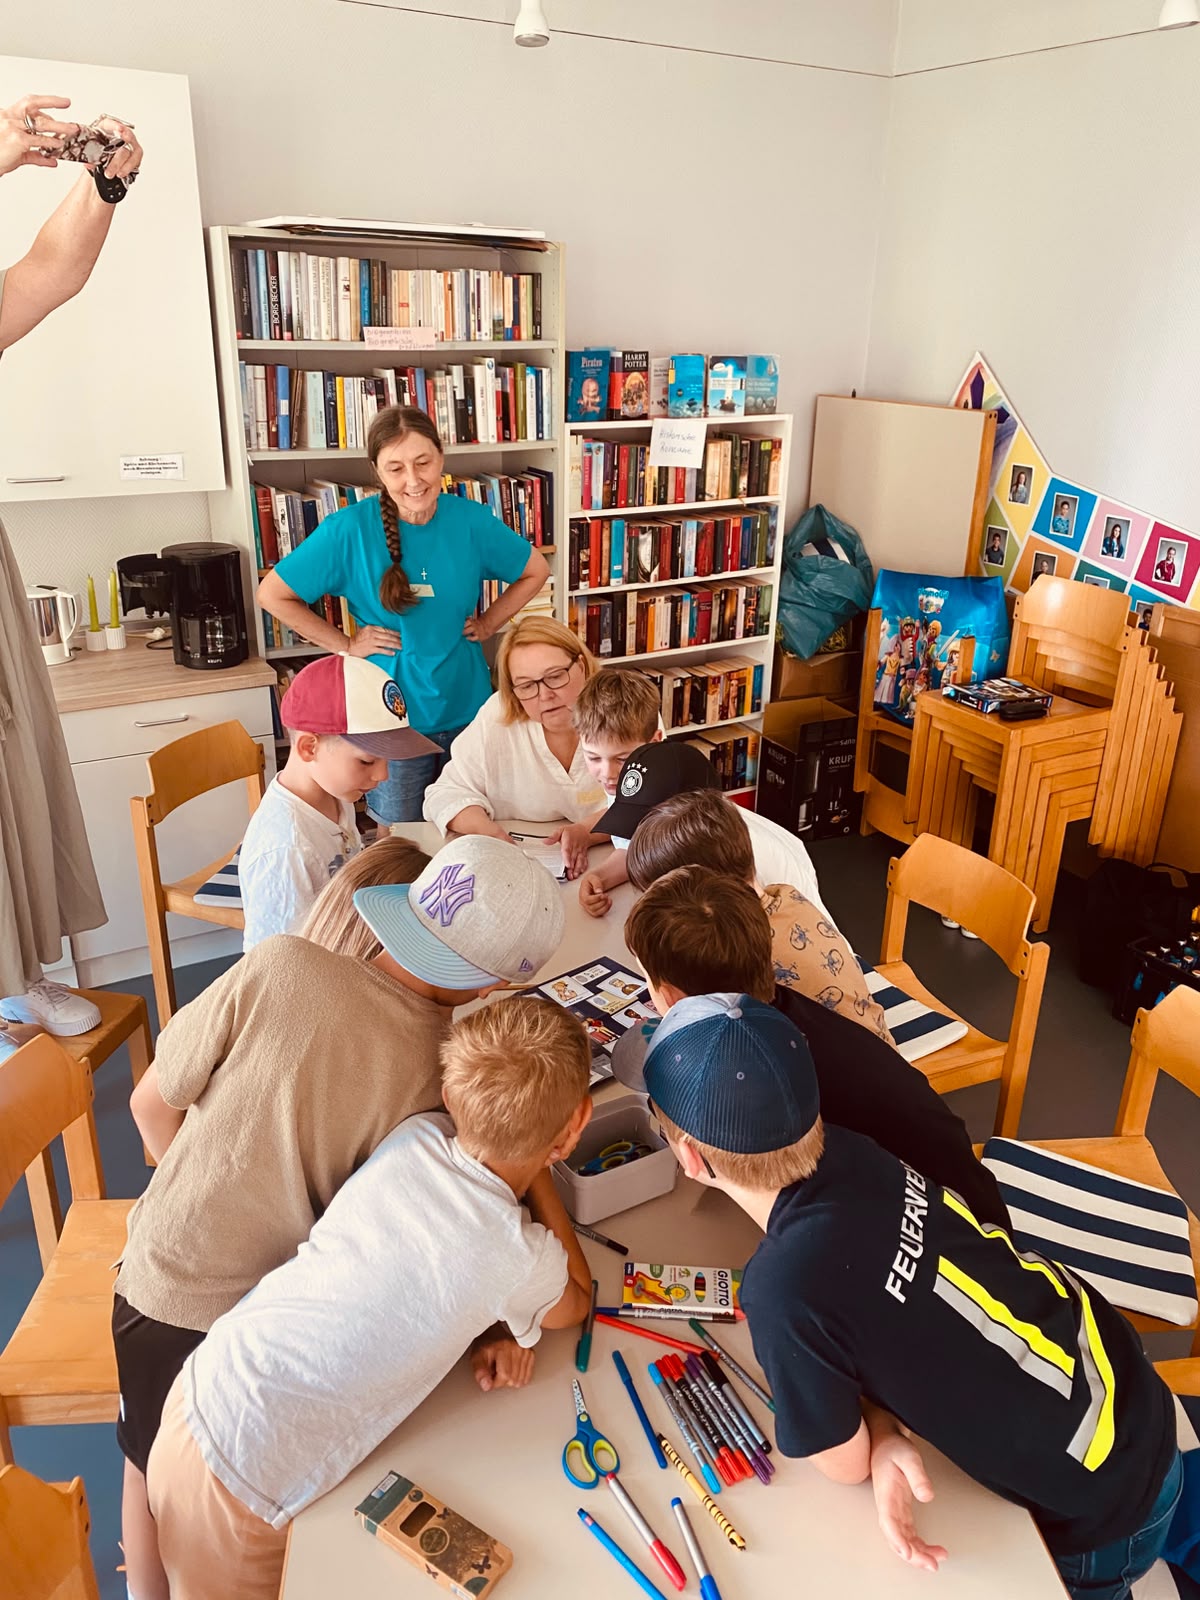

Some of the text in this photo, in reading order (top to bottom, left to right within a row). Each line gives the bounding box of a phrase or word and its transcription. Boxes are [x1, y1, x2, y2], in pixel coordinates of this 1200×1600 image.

[272, 303, 280, 324] BORIS
[581, 356, 603, 368] Piraten
[625, 353, 647, 361] HARRY
[768, 747, 787, 765] KRUPS
[828, 754, 853, 765] KRUP
[885, 1160, 929, 1304] FEUERWE
[718, 1270, 729, 1307] GIOTTO
